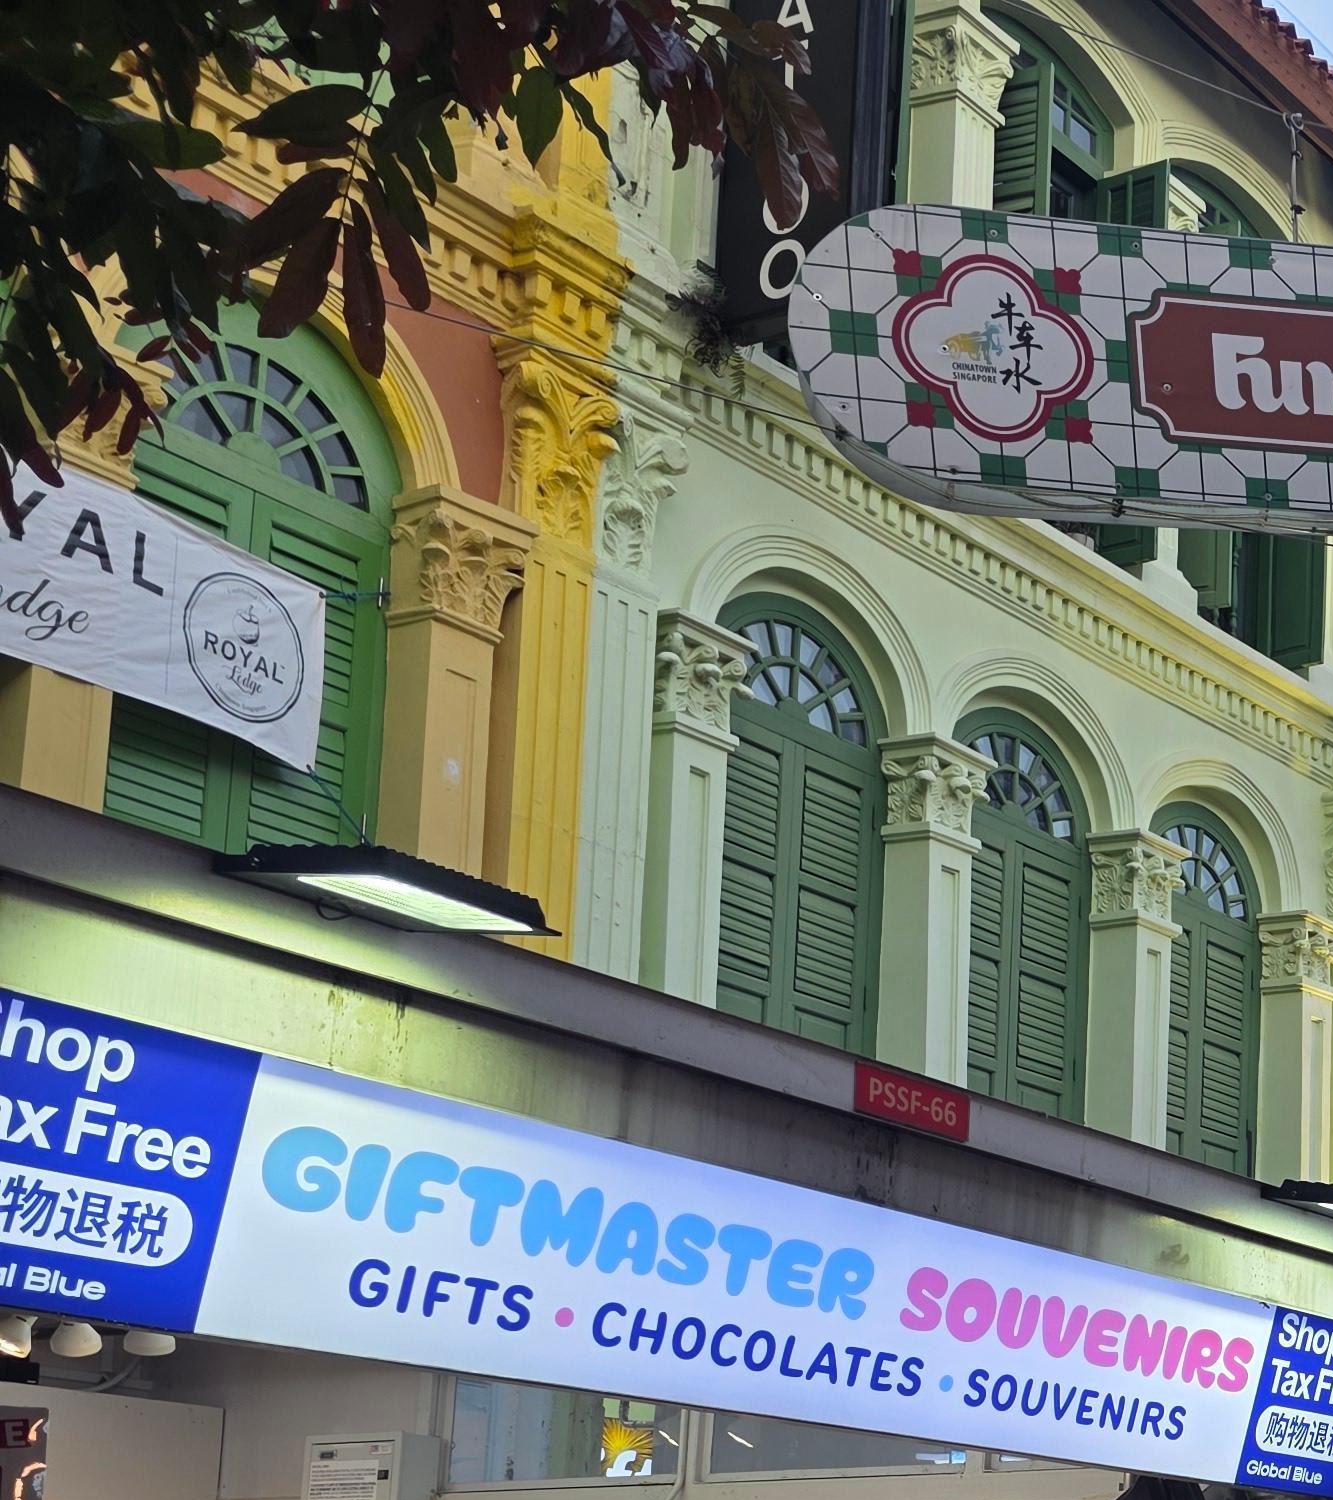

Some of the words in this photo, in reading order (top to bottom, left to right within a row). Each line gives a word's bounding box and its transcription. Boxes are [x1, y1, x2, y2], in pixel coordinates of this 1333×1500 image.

[952, 361, 997, 375] CHINATOWN
[953, 371, 998, 384] SINGAPORE
[0, 578, 90, 641] dge
[203, 629, 284, 685] ROYAL
[0, 998, 136, 1093] hop
[867, 1076, 958, 1128] PSSF-66
[63, 1095, 212, 1179] Free
[0, 1174, 169, 1258] 物退税
[23, 1265, 106, 1301] Blue
[262, 1126, 875, 1320] GIFTMASTER
[899, 1266, 1256, 1393] SOUVENIRS
[348, 1258, 534, 1332] GIFTS
[591, 1302, 925, 1397] CHOCOLATES
[963, 1368, 1187, 1441] SOUVENIRS
[1270, 1358, 1311, 1401] Tax
[1246, 1460, 1290, 1480] Global
[1293, 1465, 1323, 1486] Blue
